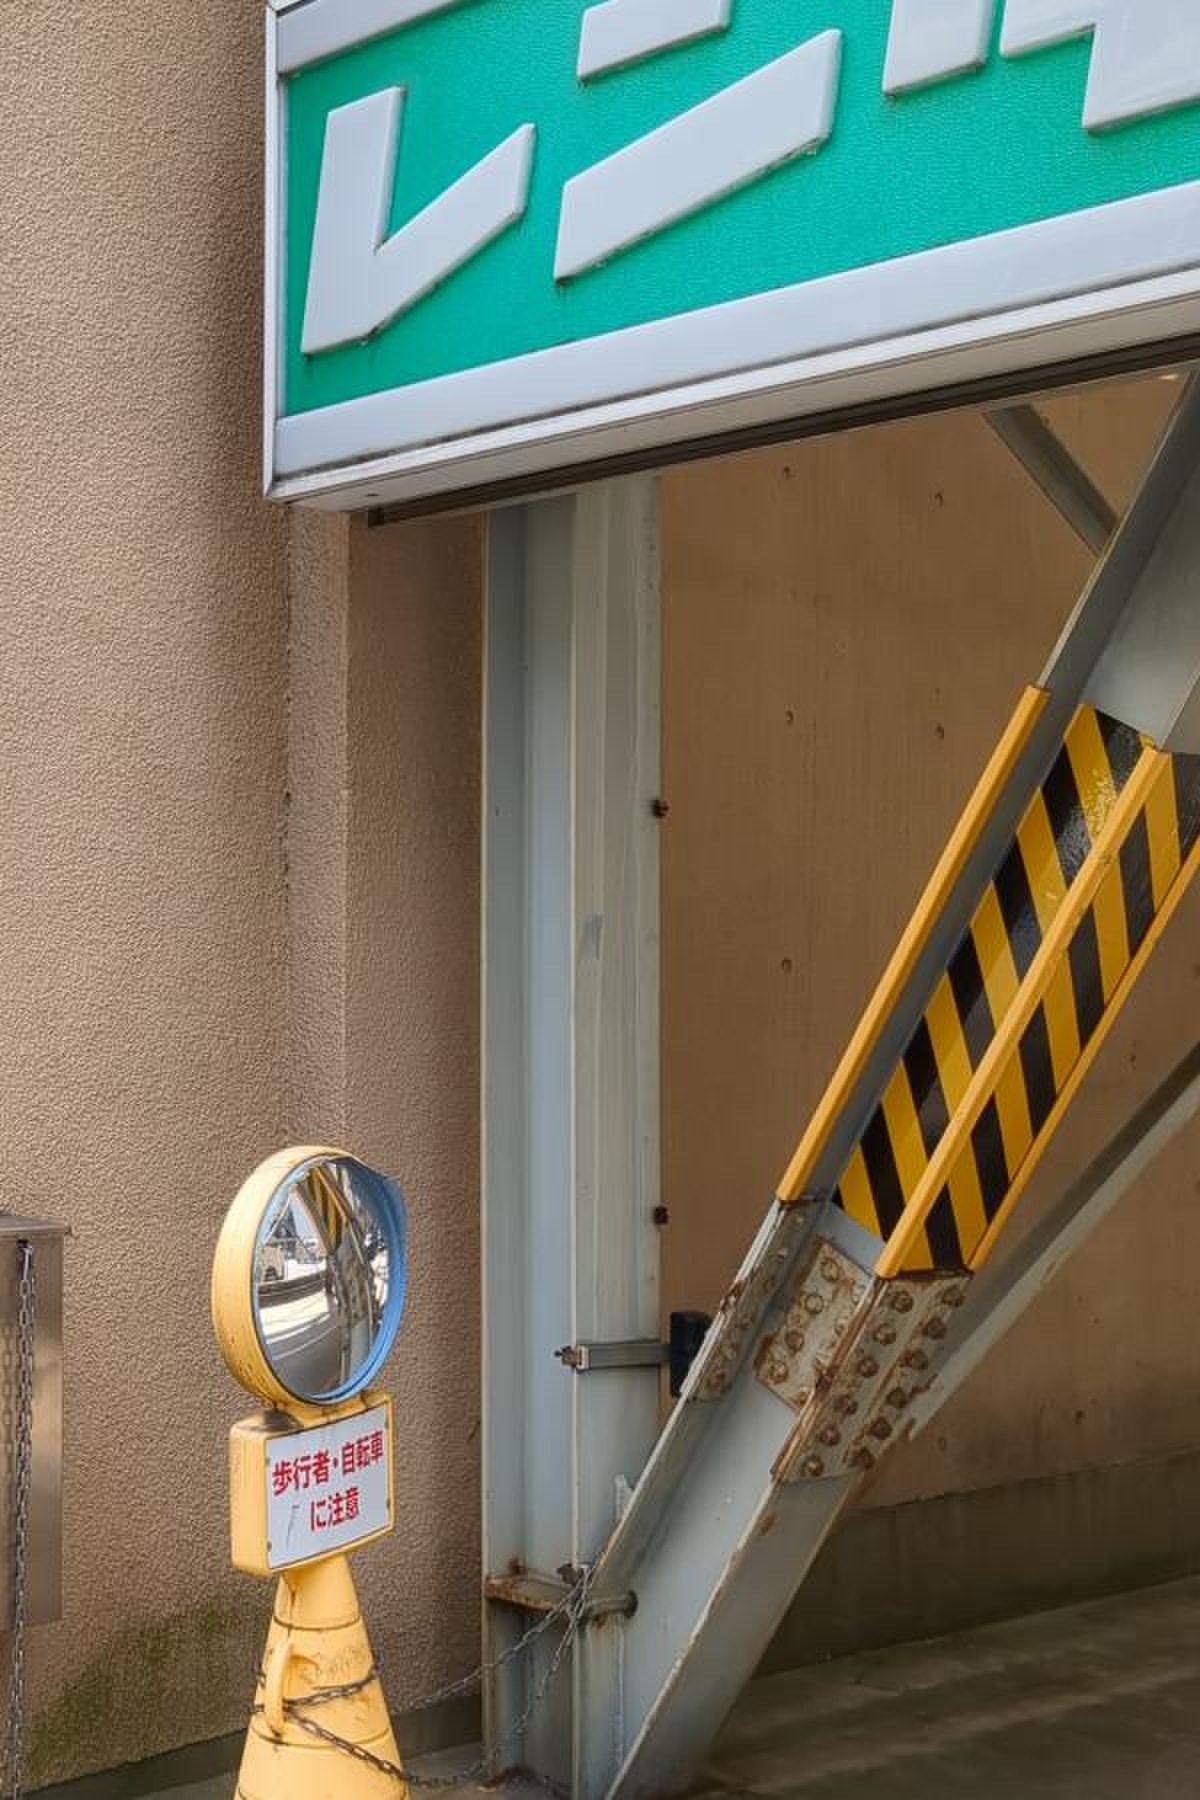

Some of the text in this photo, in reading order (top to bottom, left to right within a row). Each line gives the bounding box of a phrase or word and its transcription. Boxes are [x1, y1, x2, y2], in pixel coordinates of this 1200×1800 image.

[272, 1430, 383, 1497] 歩行者・自転車
[311, 1486, 359, 1532] に注意
